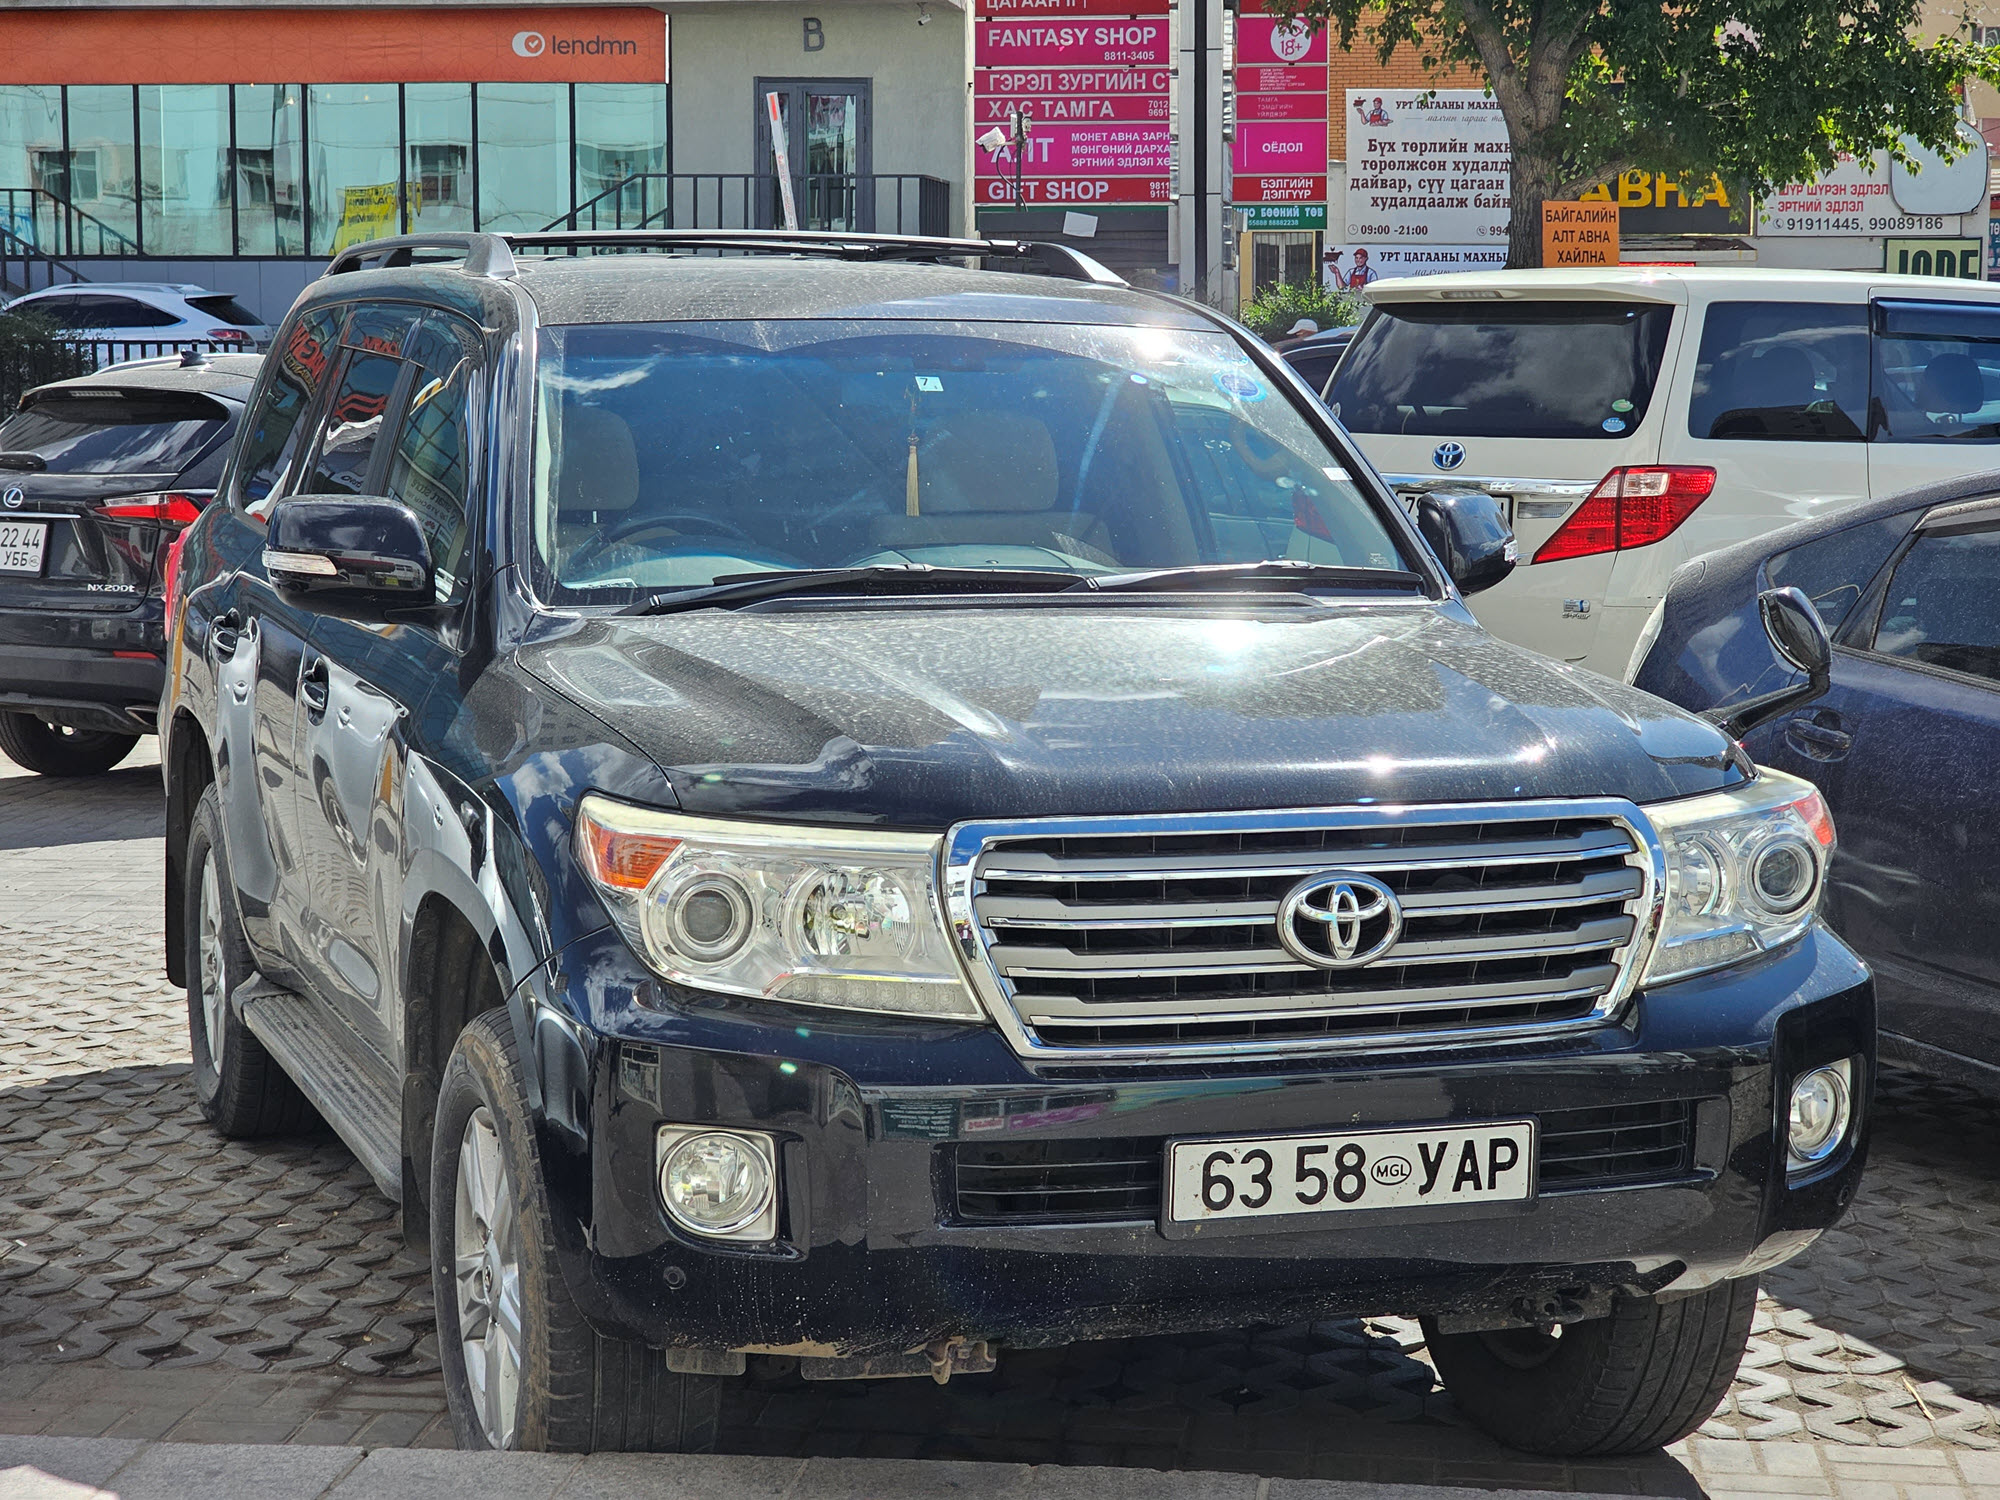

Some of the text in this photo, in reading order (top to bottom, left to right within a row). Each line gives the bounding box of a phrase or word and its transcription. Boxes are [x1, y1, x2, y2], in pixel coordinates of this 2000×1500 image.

[988, 26, 1157, 47] FANTASY SHOP
[552, 35, 637, 55] lendmn
[1280, 39, 1302, 56] 18+
[1104, 51, 1155, 61] 8811-3405
[989, 74, 1052, 91] ГЭРЭЛ
[1058, 68, 1146, 90] ЗУРГИЙН
[988, 100, 1115, 118] ХАС ТАМГА
[1148, 100, 1169, 108] 7012
[1396, 101, 1414, 110] УРТ
[1416, 101, 1465, 111] ЦАГААНЫ
[1148, 108, 1169, 116] 9691
[1071, 132, 1172, 142] МОНЕТ АВНА ЗАРН
[1071, 143, 1170, 155] МӨНГӨНИЙ ДАРХА
[1262, 141, 1303, 154] ОЁДОЛ
[1367, 138, 1396, 156] Бүх
[1401, 138, 1468, 156] төрлийн
[1071, 156, 1115, 167] ЭРТНИЙ
[1117, 157, 1154, 168] ЭДЛЭЛ
[1361, 160, 1447, 173] төрөлжсөн
[1149, 182, 1169, 190] 9811
[1261, 177, 1313, 189] БЭЛГИЙН
[1350, 175, 1505, 193] дайвар, сүү цагаан
[988, 181, 1109, 200] GIFT SHOP
[1150, 190, 1169, 198] 9111
[1262, 190, 1312, 200] ДЭЛГҮҮР
[1806, 184, 1847, 196] ШҮРЭН
[1850, 183, 1889, 197] ЭДЛЭЛ
[1370, 195, 1468, 211] худалдаалж
[1777, 199, 1822, 212] ЭРТНИЙ
[1825, 200, 1864, 214] ЭДЛЭЛ
[1545, 206, 1616, 223] БАЙГАЛИЙН
[1360, 225, 1390, 236] 09:00
[1786, 216, 1943, 232] 91911445, 99089186
[1552, 230, 1610, 243] АЛТ АВНА
[1380, 251, 1400, 262] УРТ
[1404, 251, 1459, 264] ЦАГААНЫ
[1557, 247, 1606, 263] ХАЙЛНА
[0, 527, 40, 549] 22 44
[4, 551, 29, 567] УББ
[87, 583, 135, 593] NX200t
[1201, 1137, 1519, 1211] 63 58 MGL УАР
